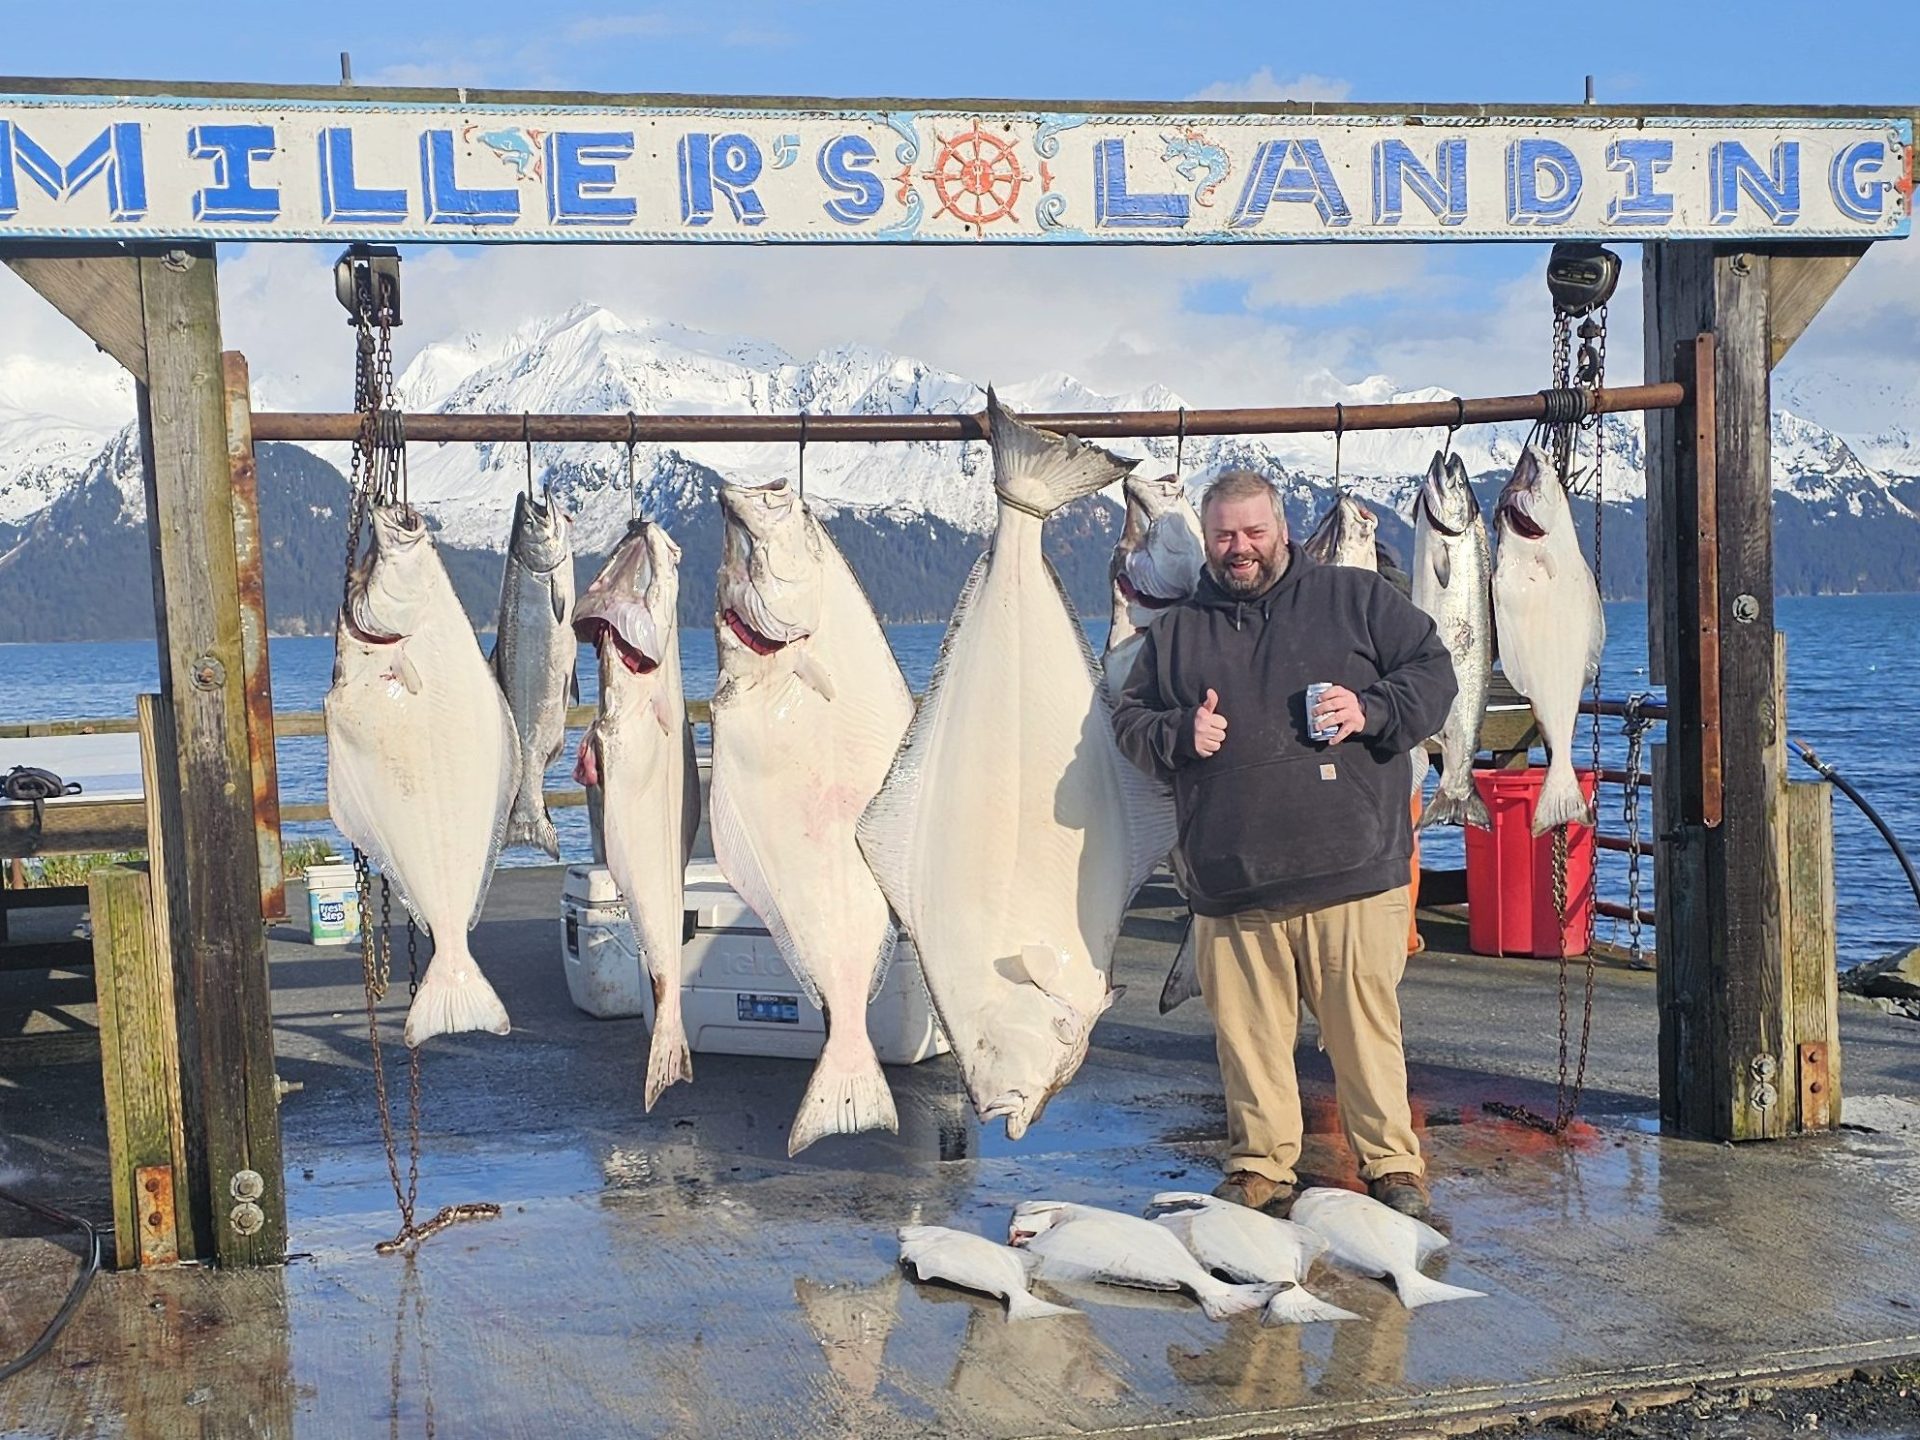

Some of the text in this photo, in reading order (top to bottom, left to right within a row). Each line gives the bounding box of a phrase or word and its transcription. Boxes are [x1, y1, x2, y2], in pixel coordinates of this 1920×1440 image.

[0, 120, 1886, 227] MILLER'S LANDING
[321, 912, 344, 921] Step
